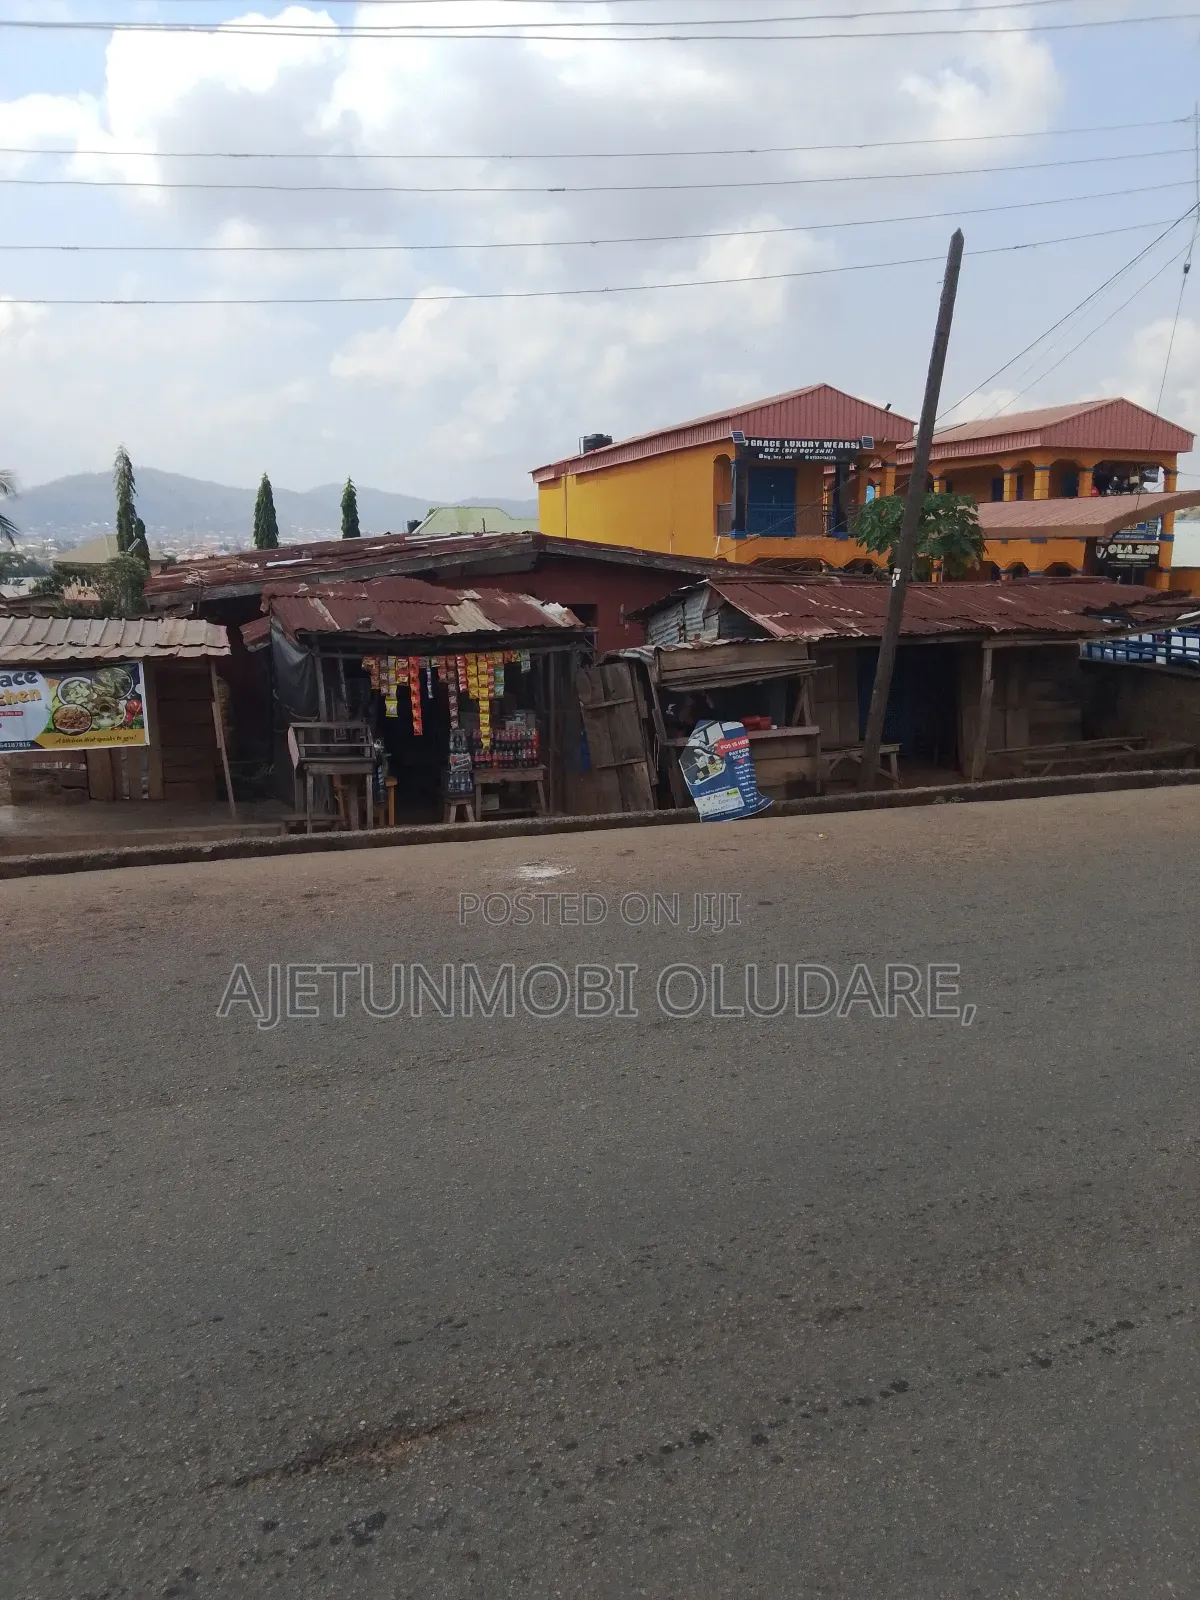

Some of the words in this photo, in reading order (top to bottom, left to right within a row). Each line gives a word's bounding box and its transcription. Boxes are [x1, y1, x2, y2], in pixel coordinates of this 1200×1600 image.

[750, 439, 781, 447] GRACE
[784, 440, 820, 448] LUXURY
[824, 441, 857, 449] WEARS
[1107, 544, 1133, 554] OLA
[0, 671, 39, 688] ace
